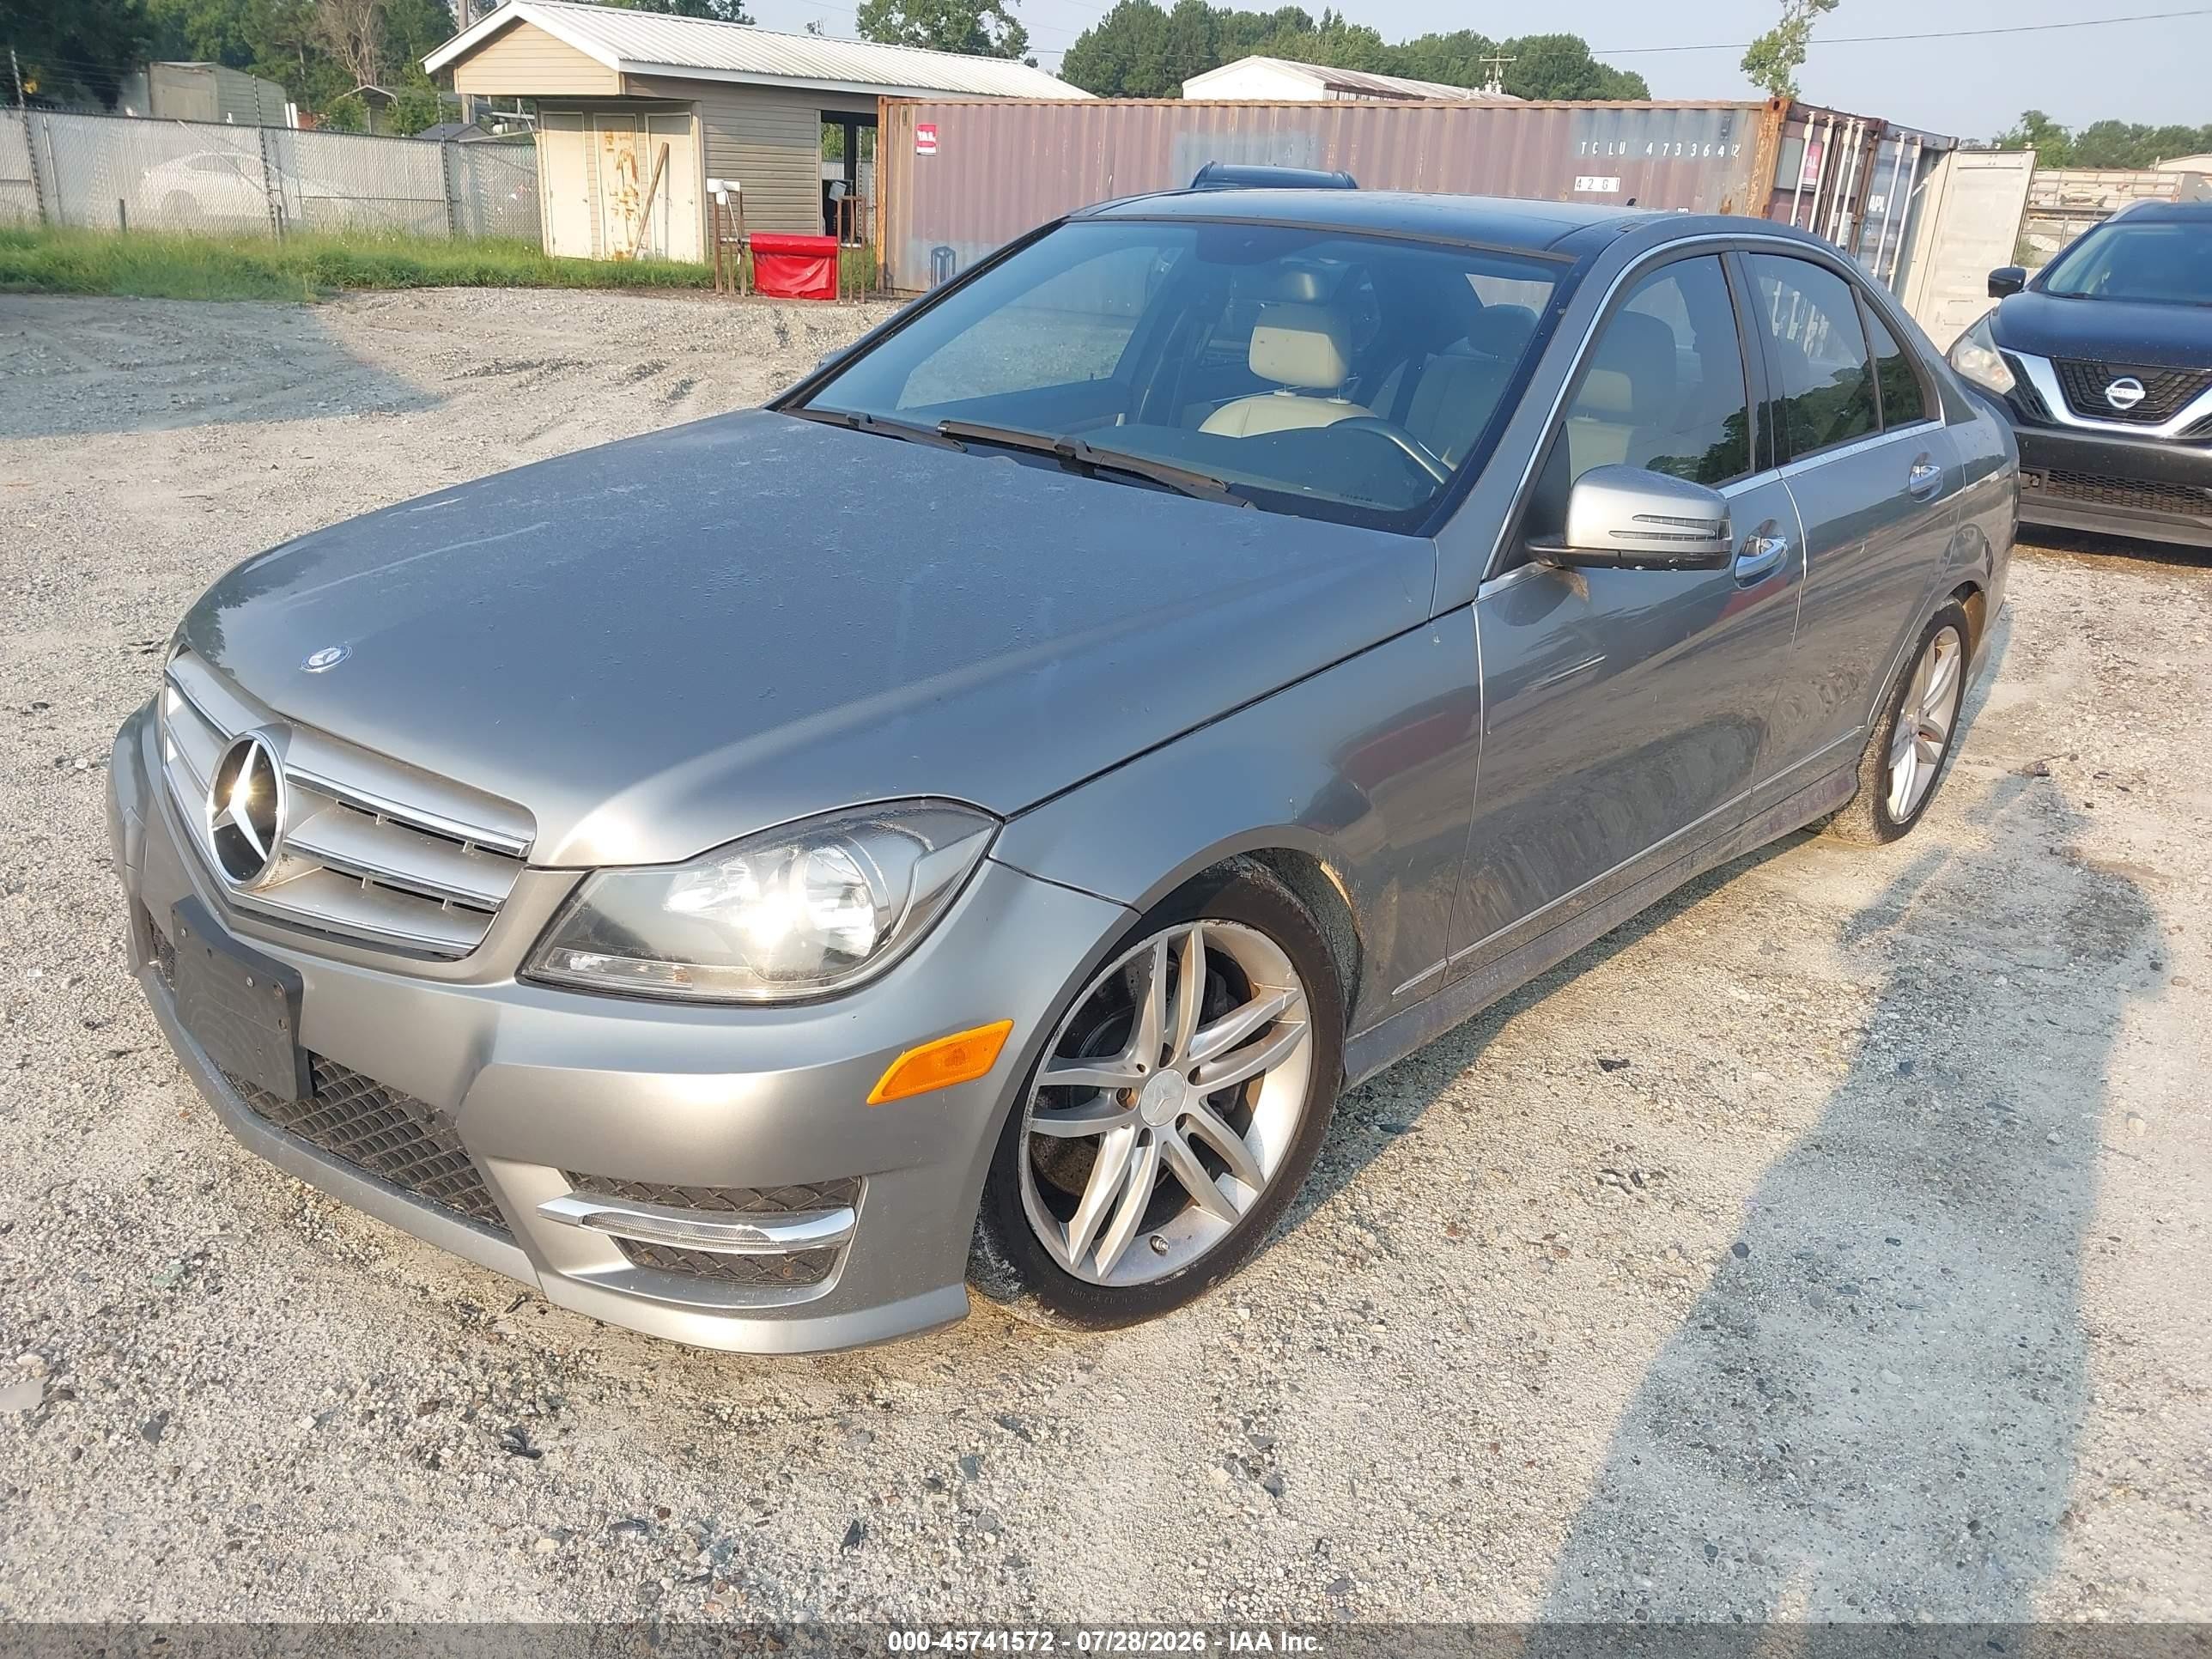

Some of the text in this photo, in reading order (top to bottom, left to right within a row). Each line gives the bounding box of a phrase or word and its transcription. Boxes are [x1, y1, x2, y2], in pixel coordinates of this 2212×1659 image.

[1580, 141, 1626, 155] TCLU
[1645, 142, 1725, 158] 473364
[1868, 194, 1885, 213] APL
